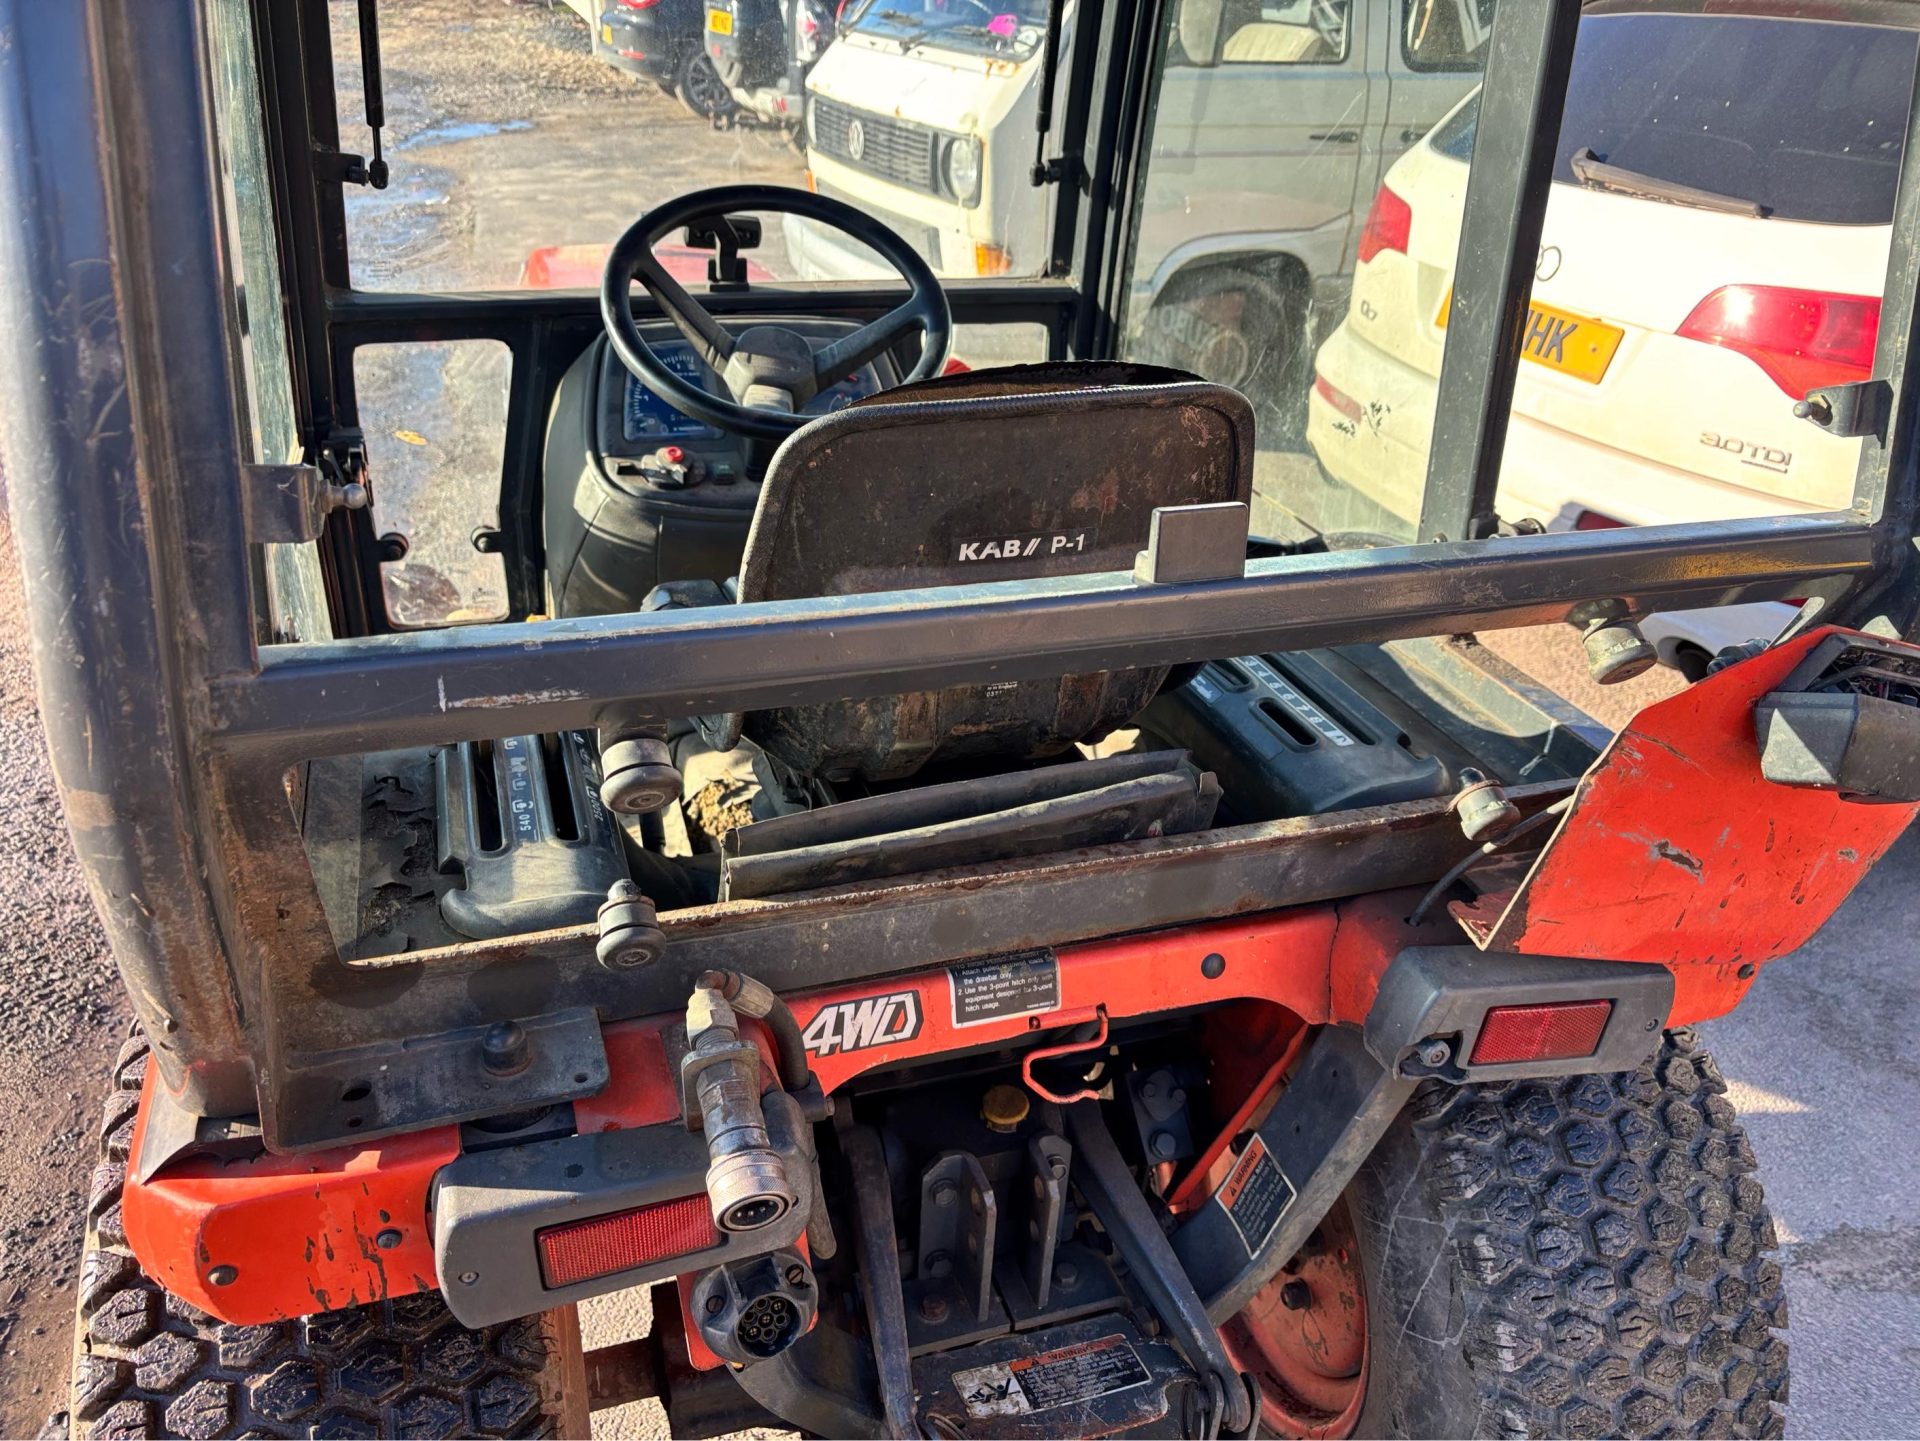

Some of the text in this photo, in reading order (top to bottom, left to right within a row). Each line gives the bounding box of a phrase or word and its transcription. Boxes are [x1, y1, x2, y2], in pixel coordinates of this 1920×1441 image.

[1522, 309, 1578, 363] HK
[1050, 533, 1085, 554] P-1
[519, 814, 532, 831] 540
[964, 987, 976, 995] Use
[989, 982, 1010, 991] 3-point
[964, 992, 995, 1005] equipment
[965, 1004, 980, 1012] hitch
[802, 992, 917, 1055] 4WD
[1234, 1150, 1258, 1185] WARNING
